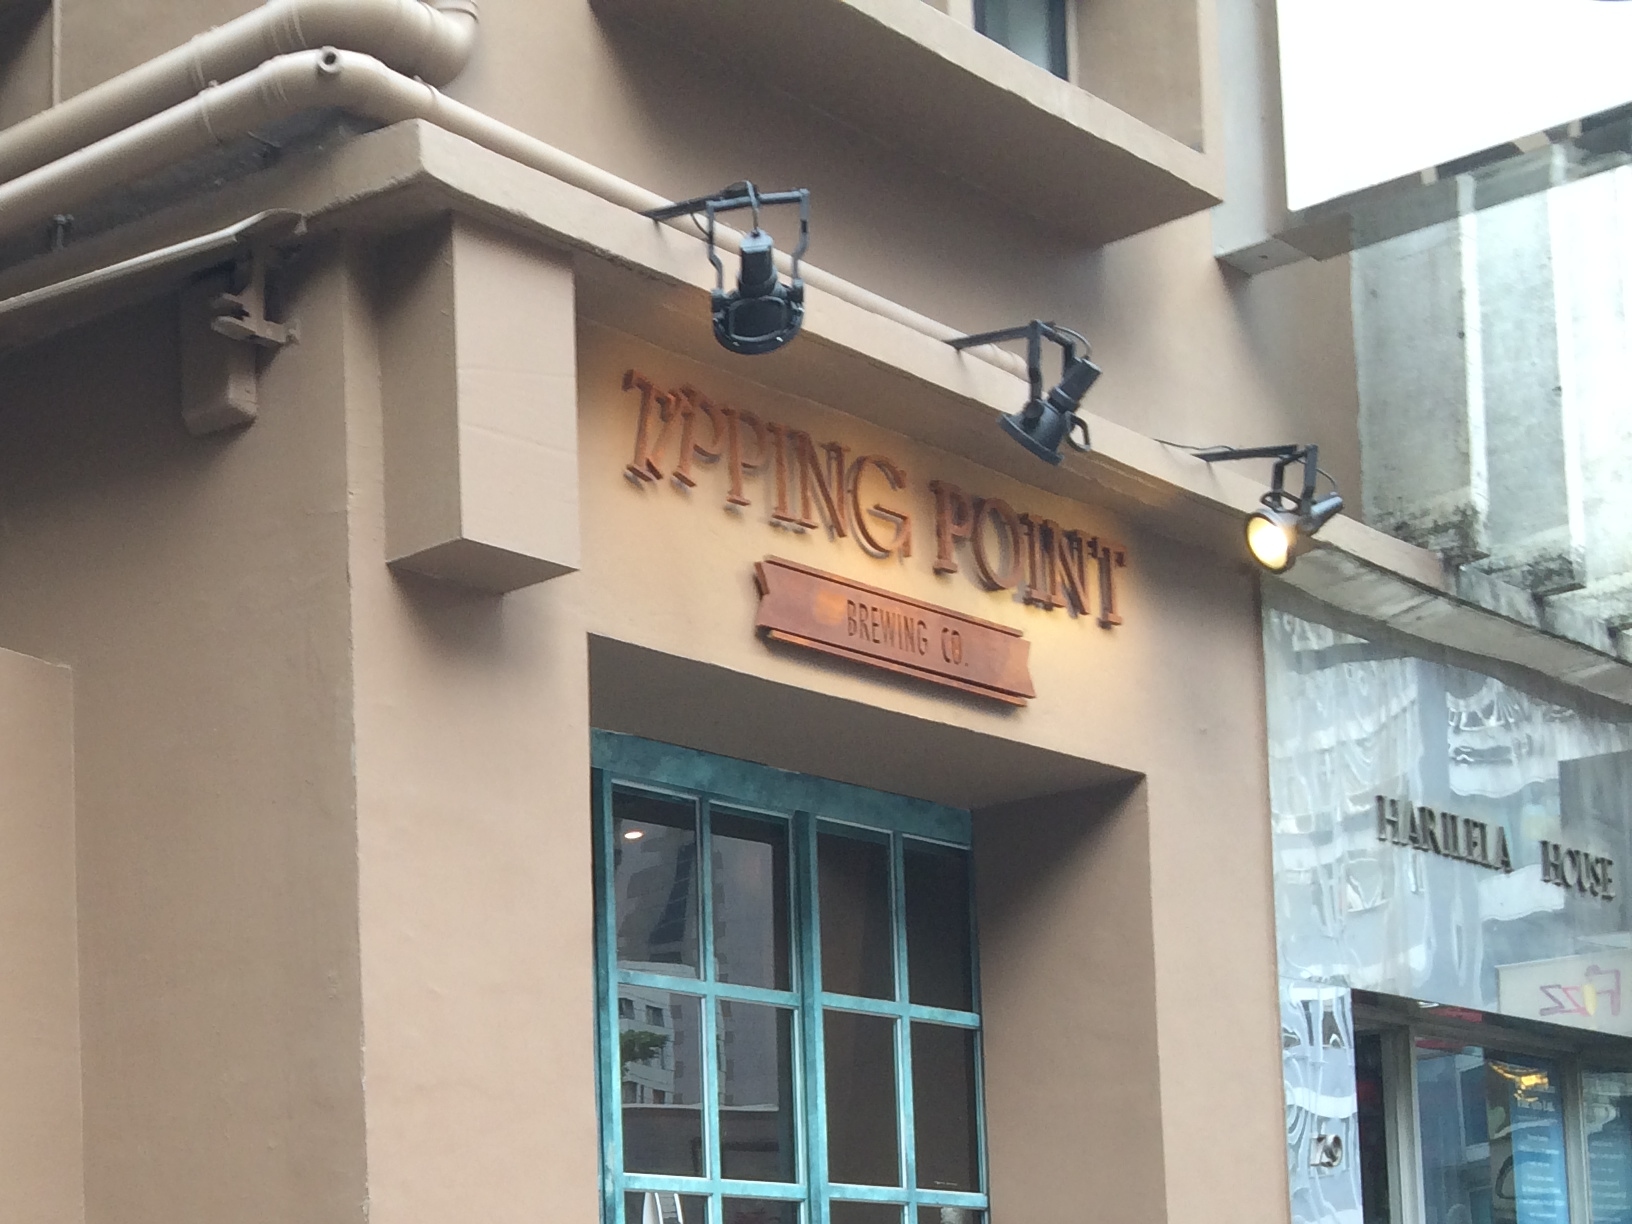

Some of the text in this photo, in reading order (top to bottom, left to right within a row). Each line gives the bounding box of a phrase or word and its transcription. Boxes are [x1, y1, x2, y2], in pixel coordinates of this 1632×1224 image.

[930, 479, 1127, 628] POINT
[846, 599, 969, 667] BREWING CO.
[1375, 795, 1616, 901] HARILELA HOUSE
